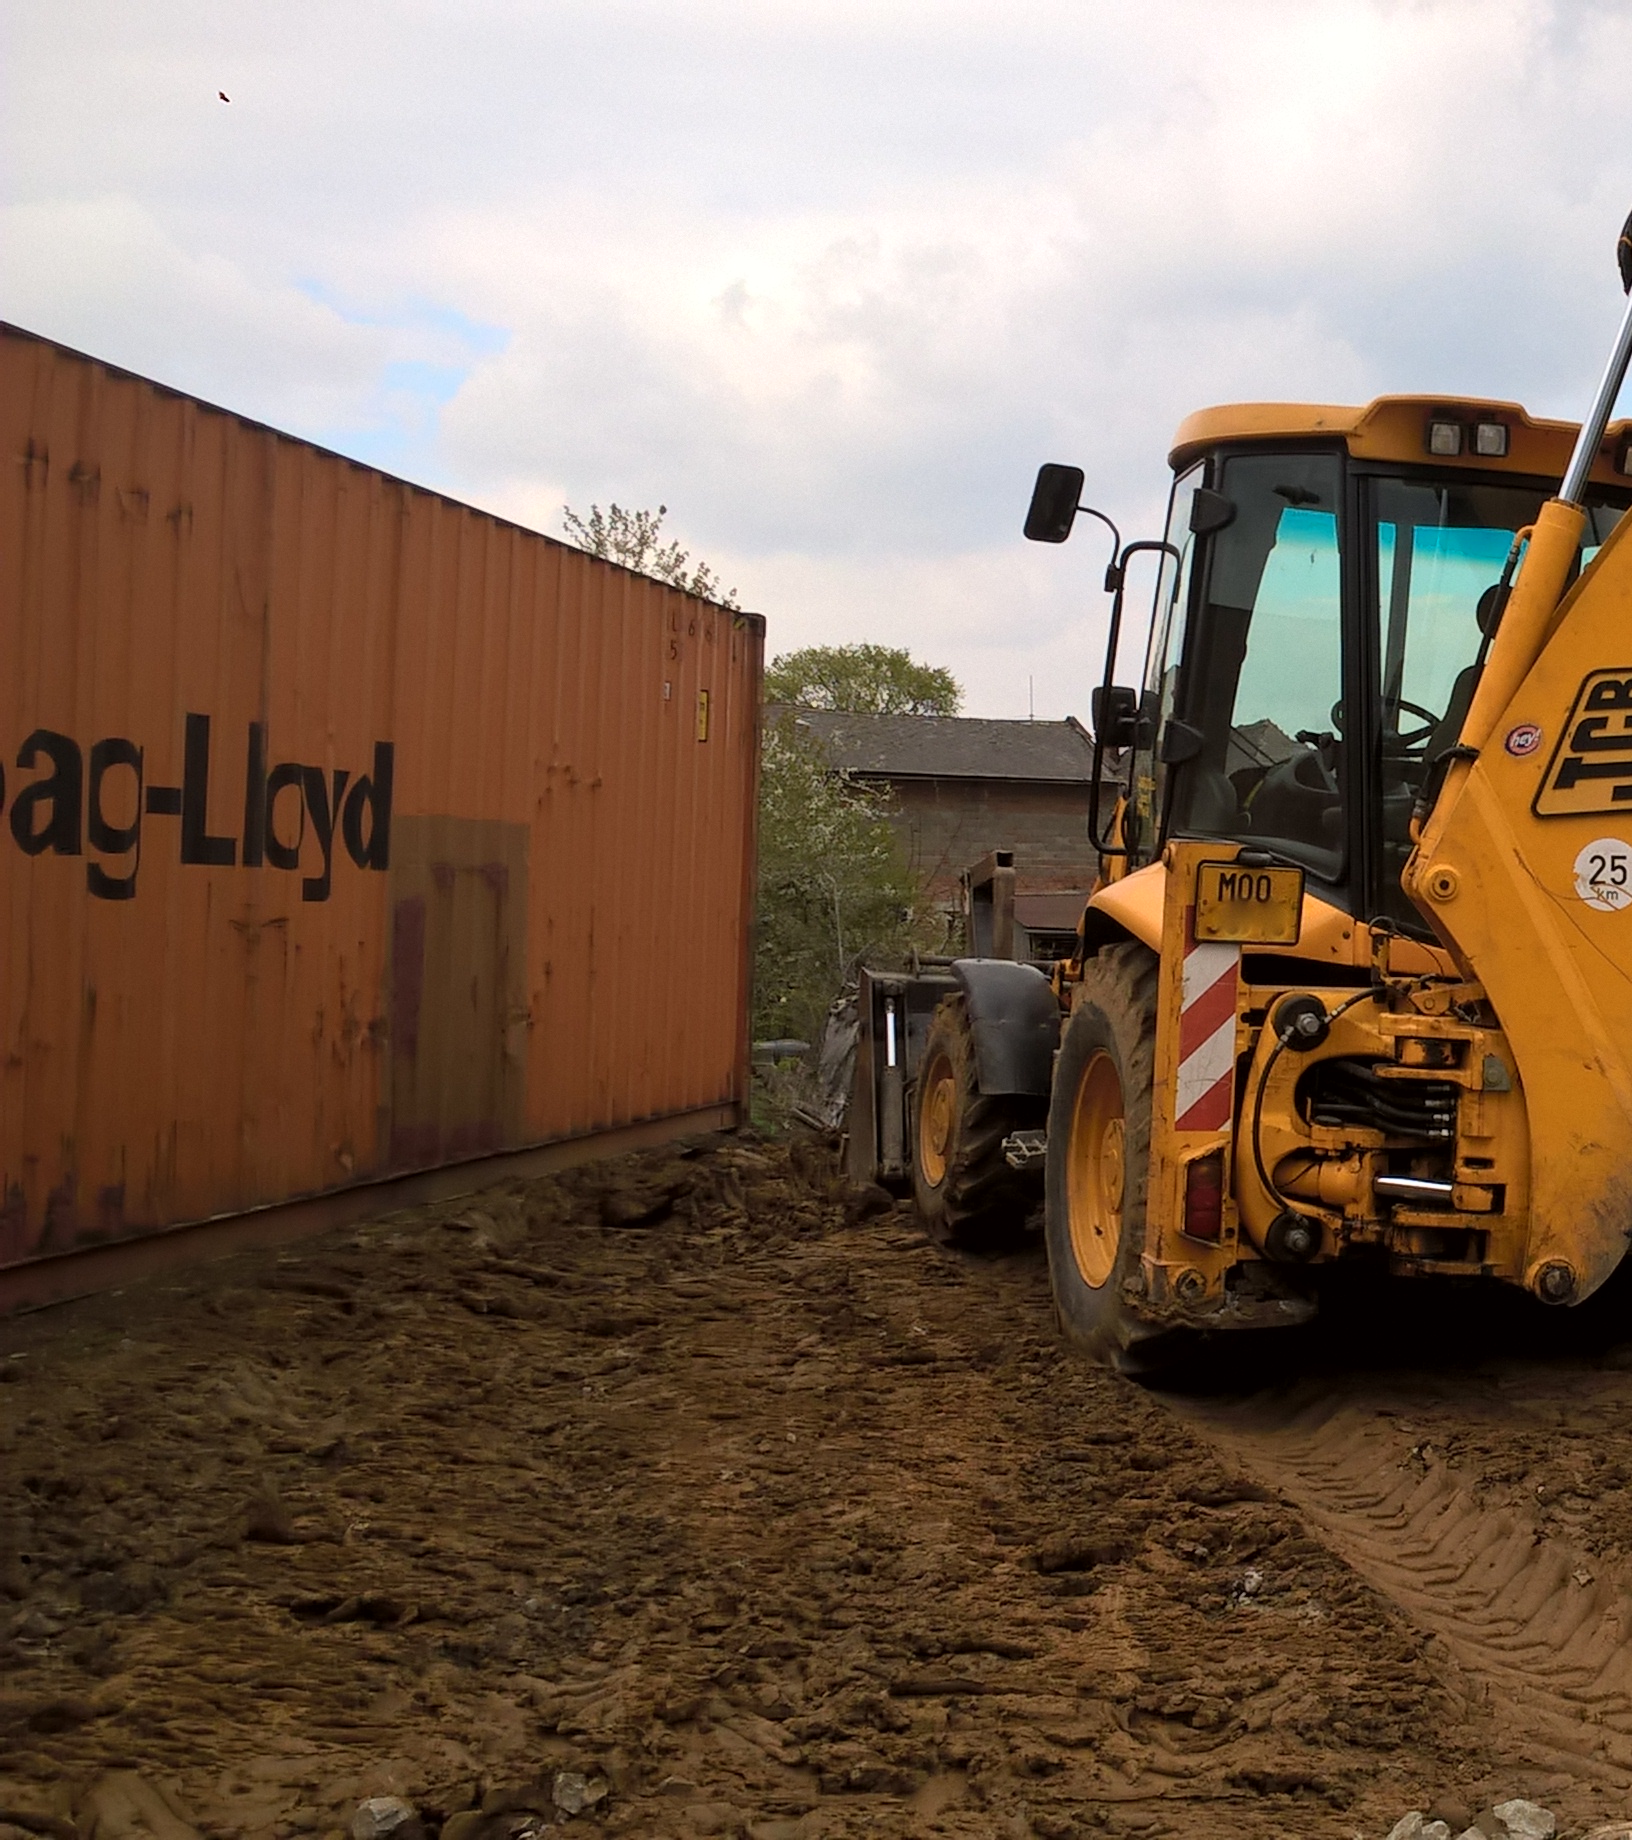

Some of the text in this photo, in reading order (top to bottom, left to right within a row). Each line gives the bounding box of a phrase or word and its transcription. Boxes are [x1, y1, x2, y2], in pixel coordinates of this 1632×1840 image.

[0, 711, 394, 902] ag-Lloyd
[1588, 855, 1628, 886] 25
[1596, 887, 1619, 901] km
